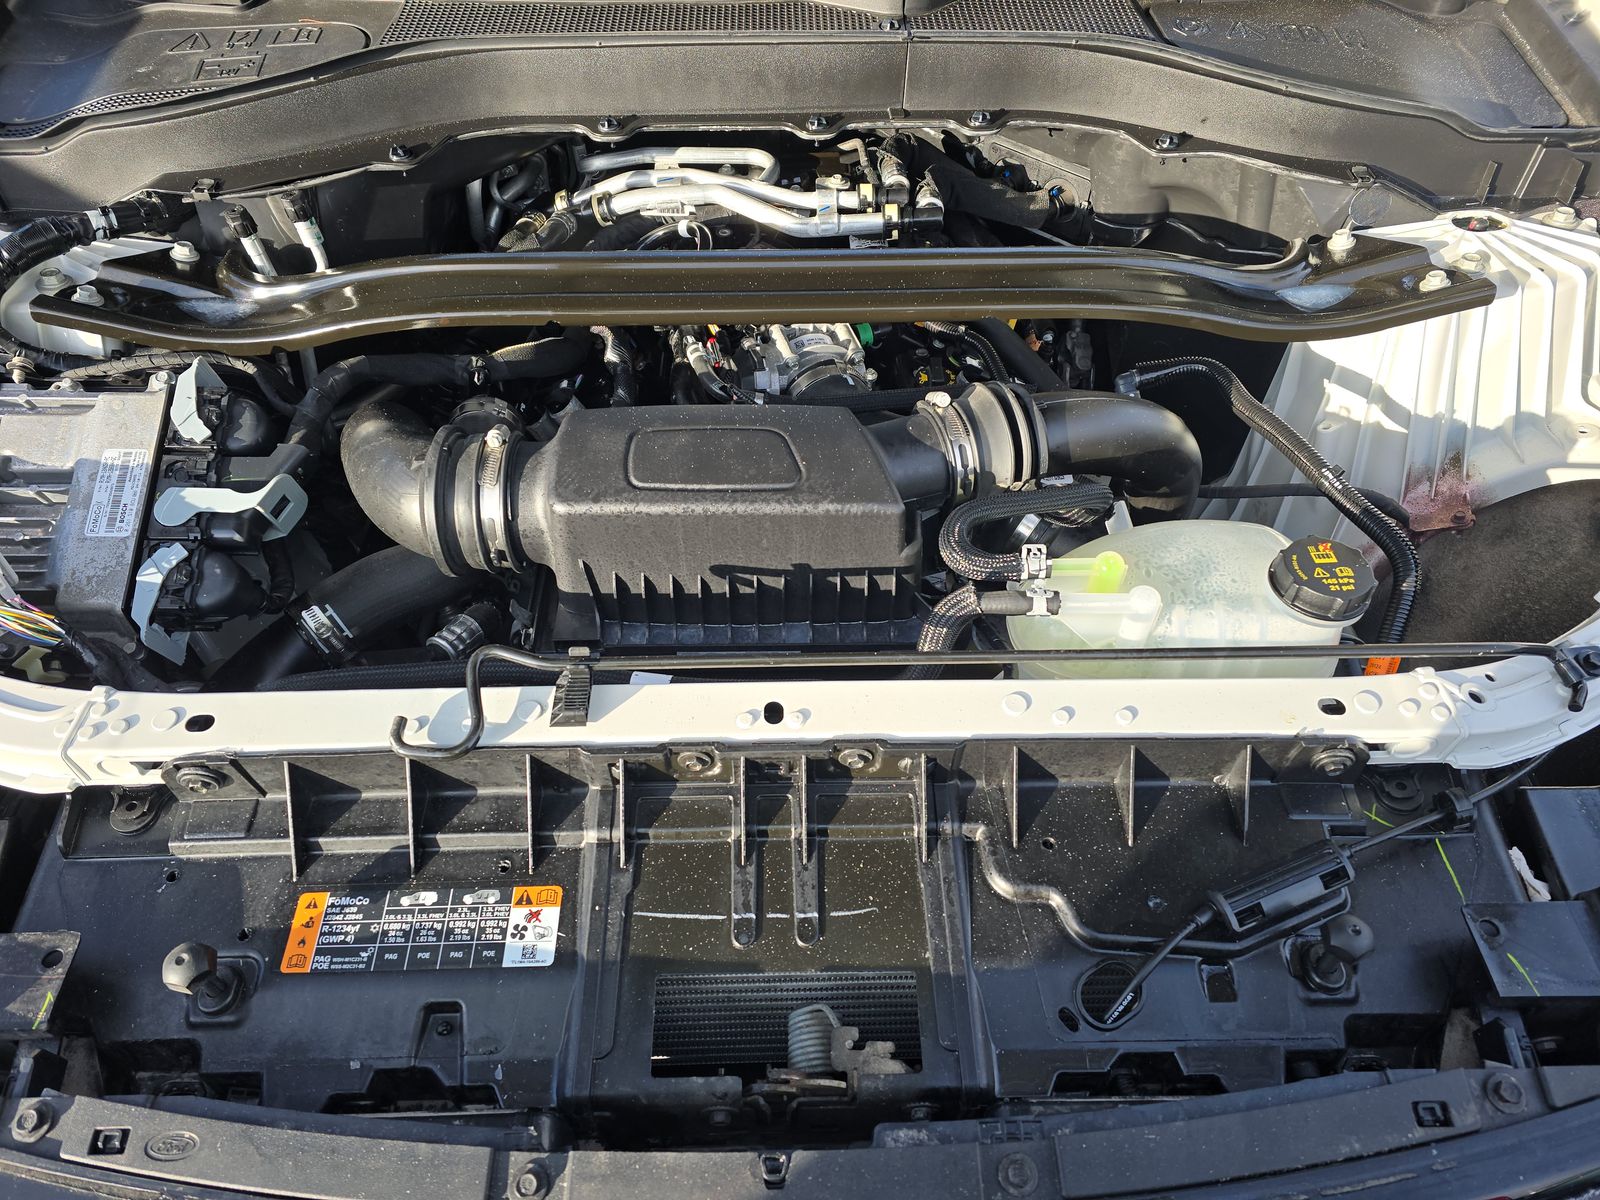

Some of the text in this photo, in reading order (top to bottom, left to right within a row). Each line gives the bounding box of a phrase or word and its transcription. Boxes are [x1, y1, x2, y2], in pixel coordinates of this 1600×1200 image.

[118, 503, 128, 524] BOSCH
[89, 505, 103, 533] FoMoCo
[1341, 584, 1356, 592] psi
[328, 896, 370, 906] FoMoCo
[402, 922, 411, 931] kg
[433, 922, 443, 930] kg
[449, 920, 476, 929] 0.992 kg
[480, 920, 507, 928] 0.992 kg
[322, 924, 361, 934] R-1234yf
[319, 934, 355, 944] (GWP 4)
[312, 962, 330, 970] POE
